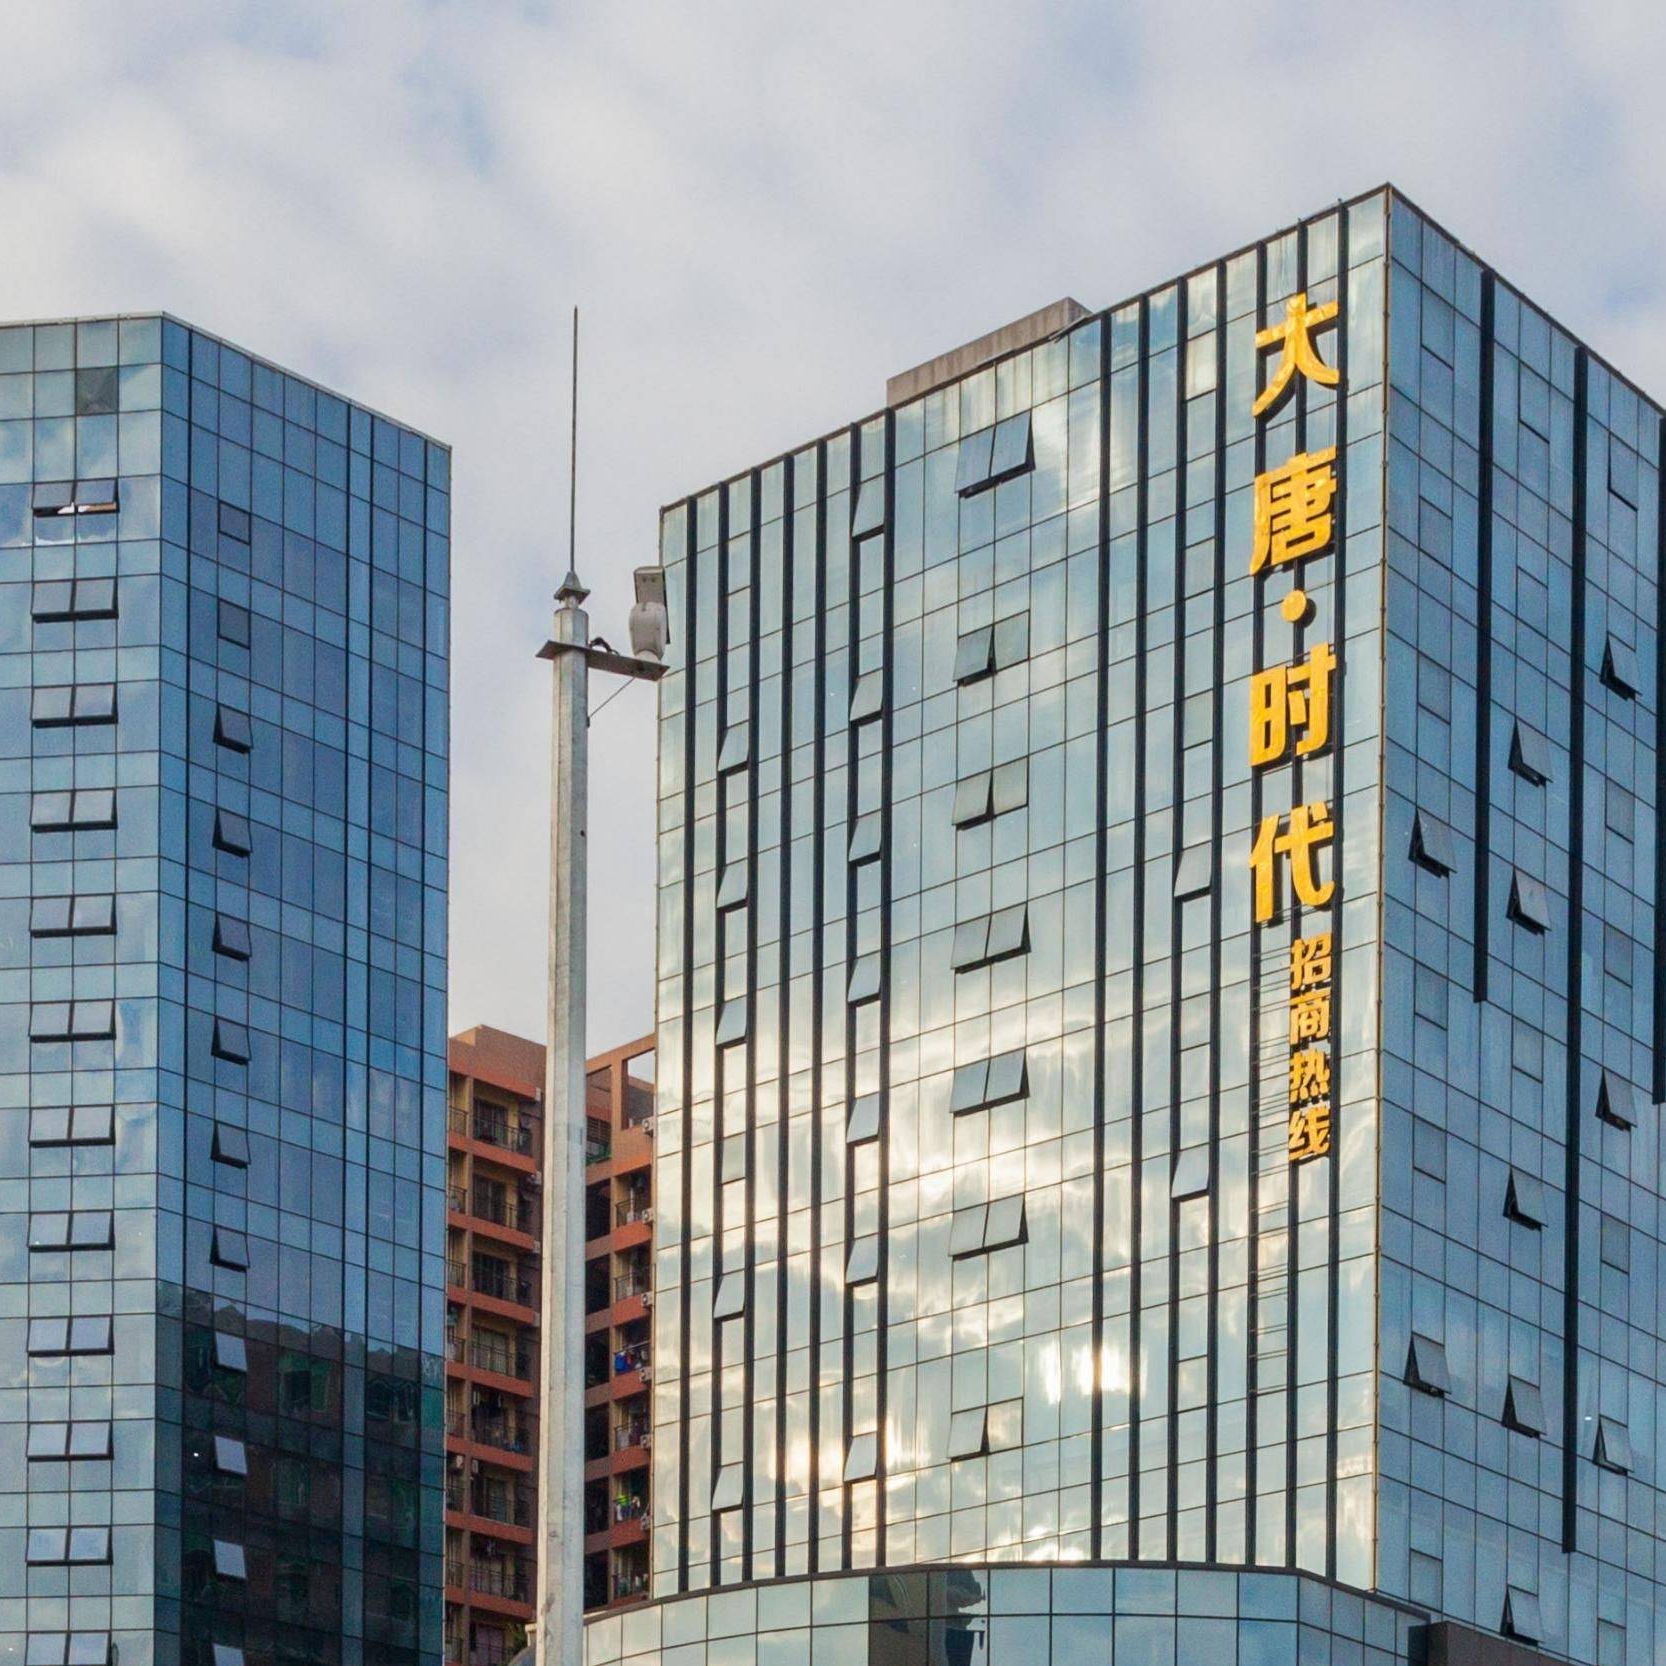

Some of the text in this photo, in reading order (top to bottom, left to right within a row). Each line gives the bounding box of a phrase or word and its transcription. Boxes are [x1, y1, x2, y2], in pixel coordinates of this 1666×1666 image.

[1249, 292, 1340, 924] 大唐·时代
[1287, 932, 1332, 1162] 招商热线
